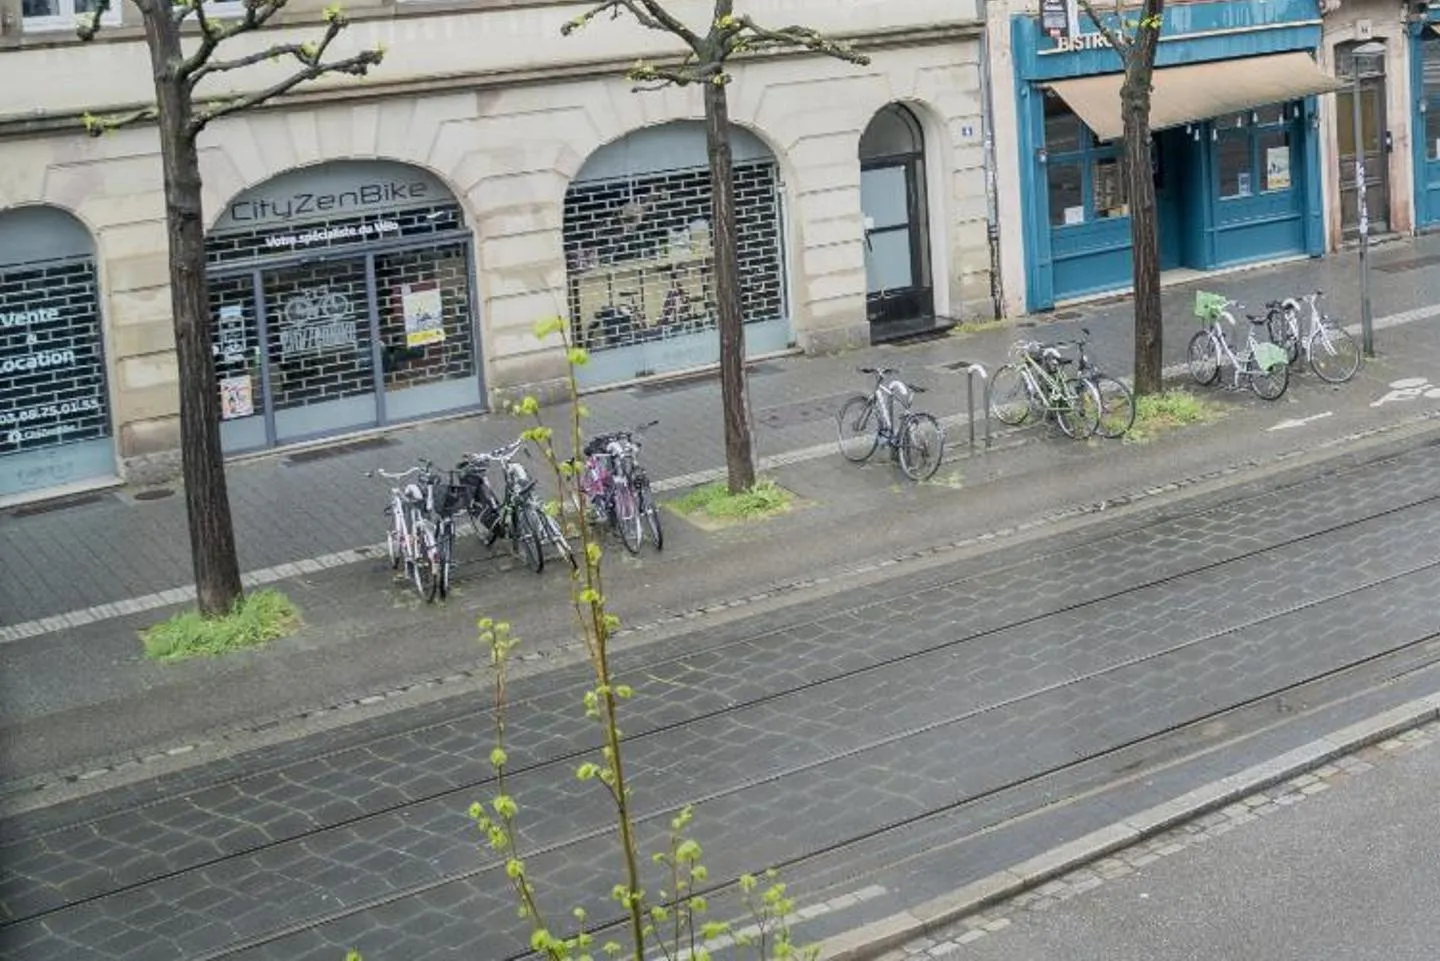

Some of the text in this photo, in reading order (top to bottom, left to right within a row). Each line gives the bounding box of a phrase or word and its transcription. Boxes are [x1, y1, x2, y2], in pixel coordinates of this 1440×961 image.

[231, 180, 428, 221] CityZenBike
[0, 307, 59, 328] Vente
[0, 350, 75, 373] ocation
